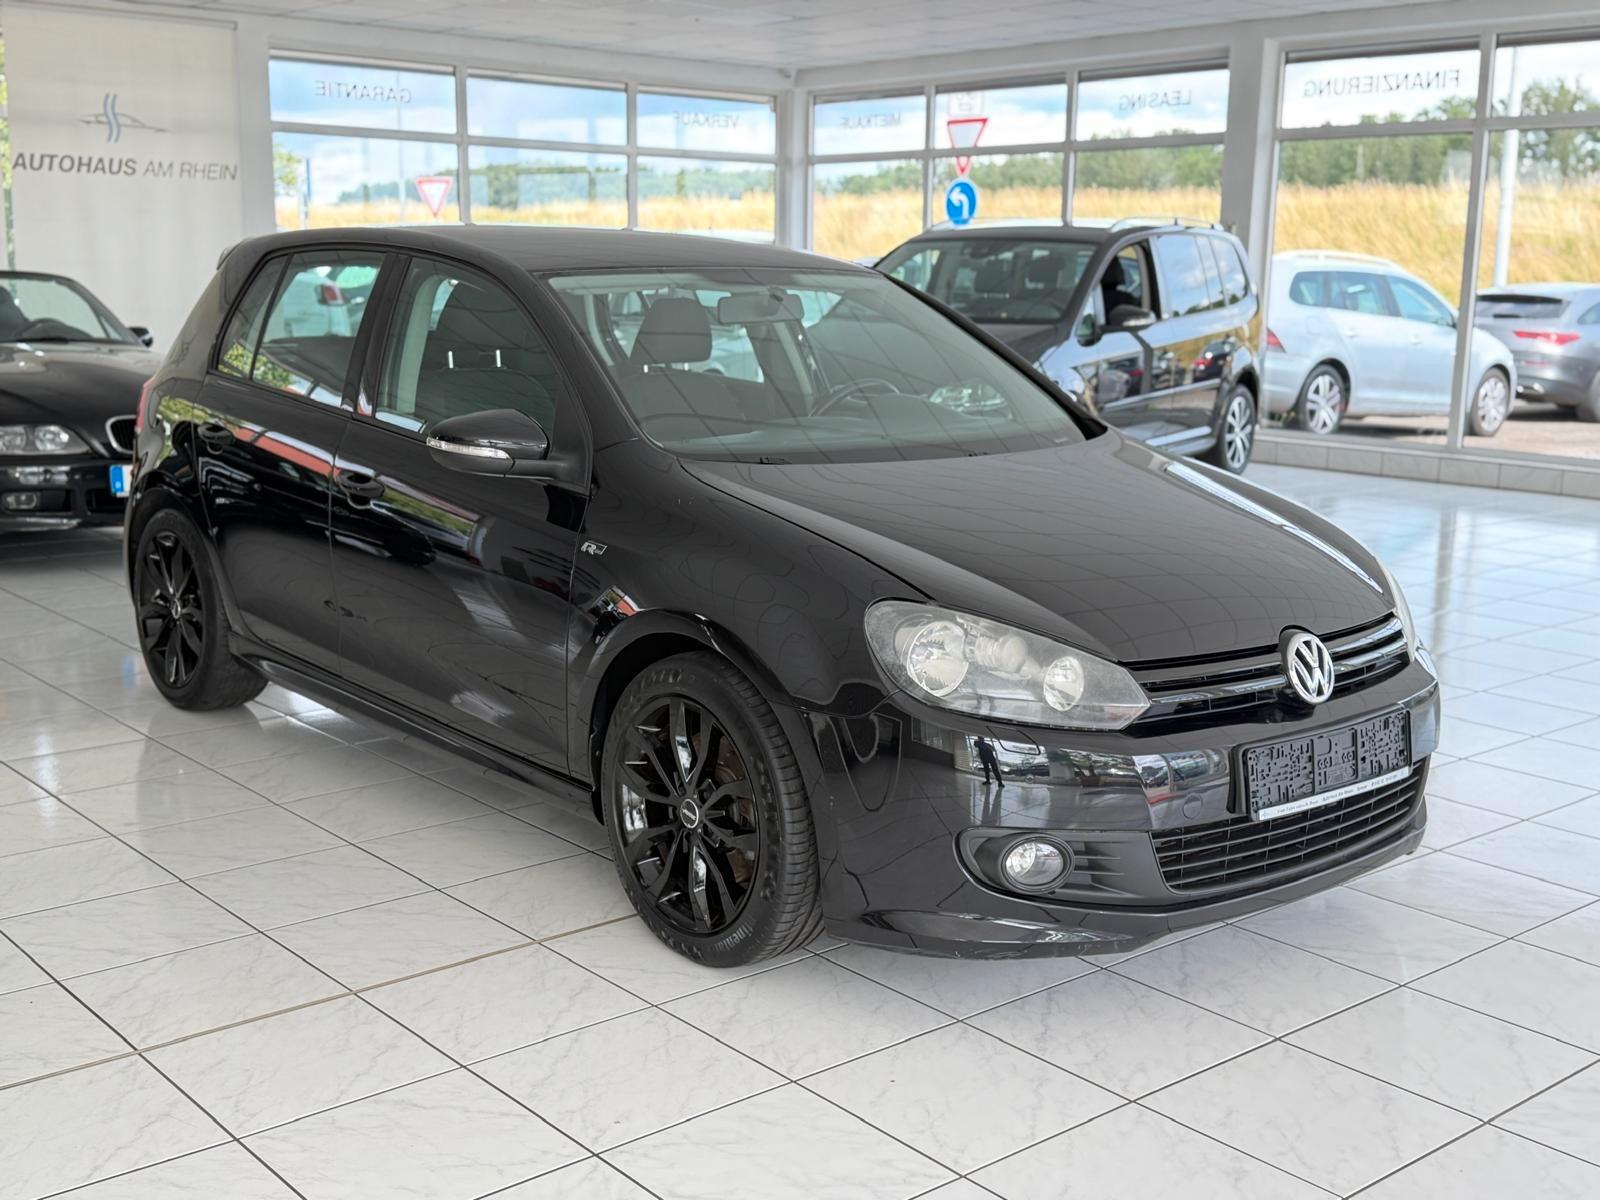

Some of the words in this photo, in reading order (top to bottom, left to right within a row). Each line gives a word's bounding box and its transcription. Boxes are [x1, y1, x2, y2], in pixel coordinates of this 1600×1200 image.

[12, 152, 137, 177] AUTOHAUS
[143, 161, 174, 179] AM
[179, 162, 238, 181] RHEIN
